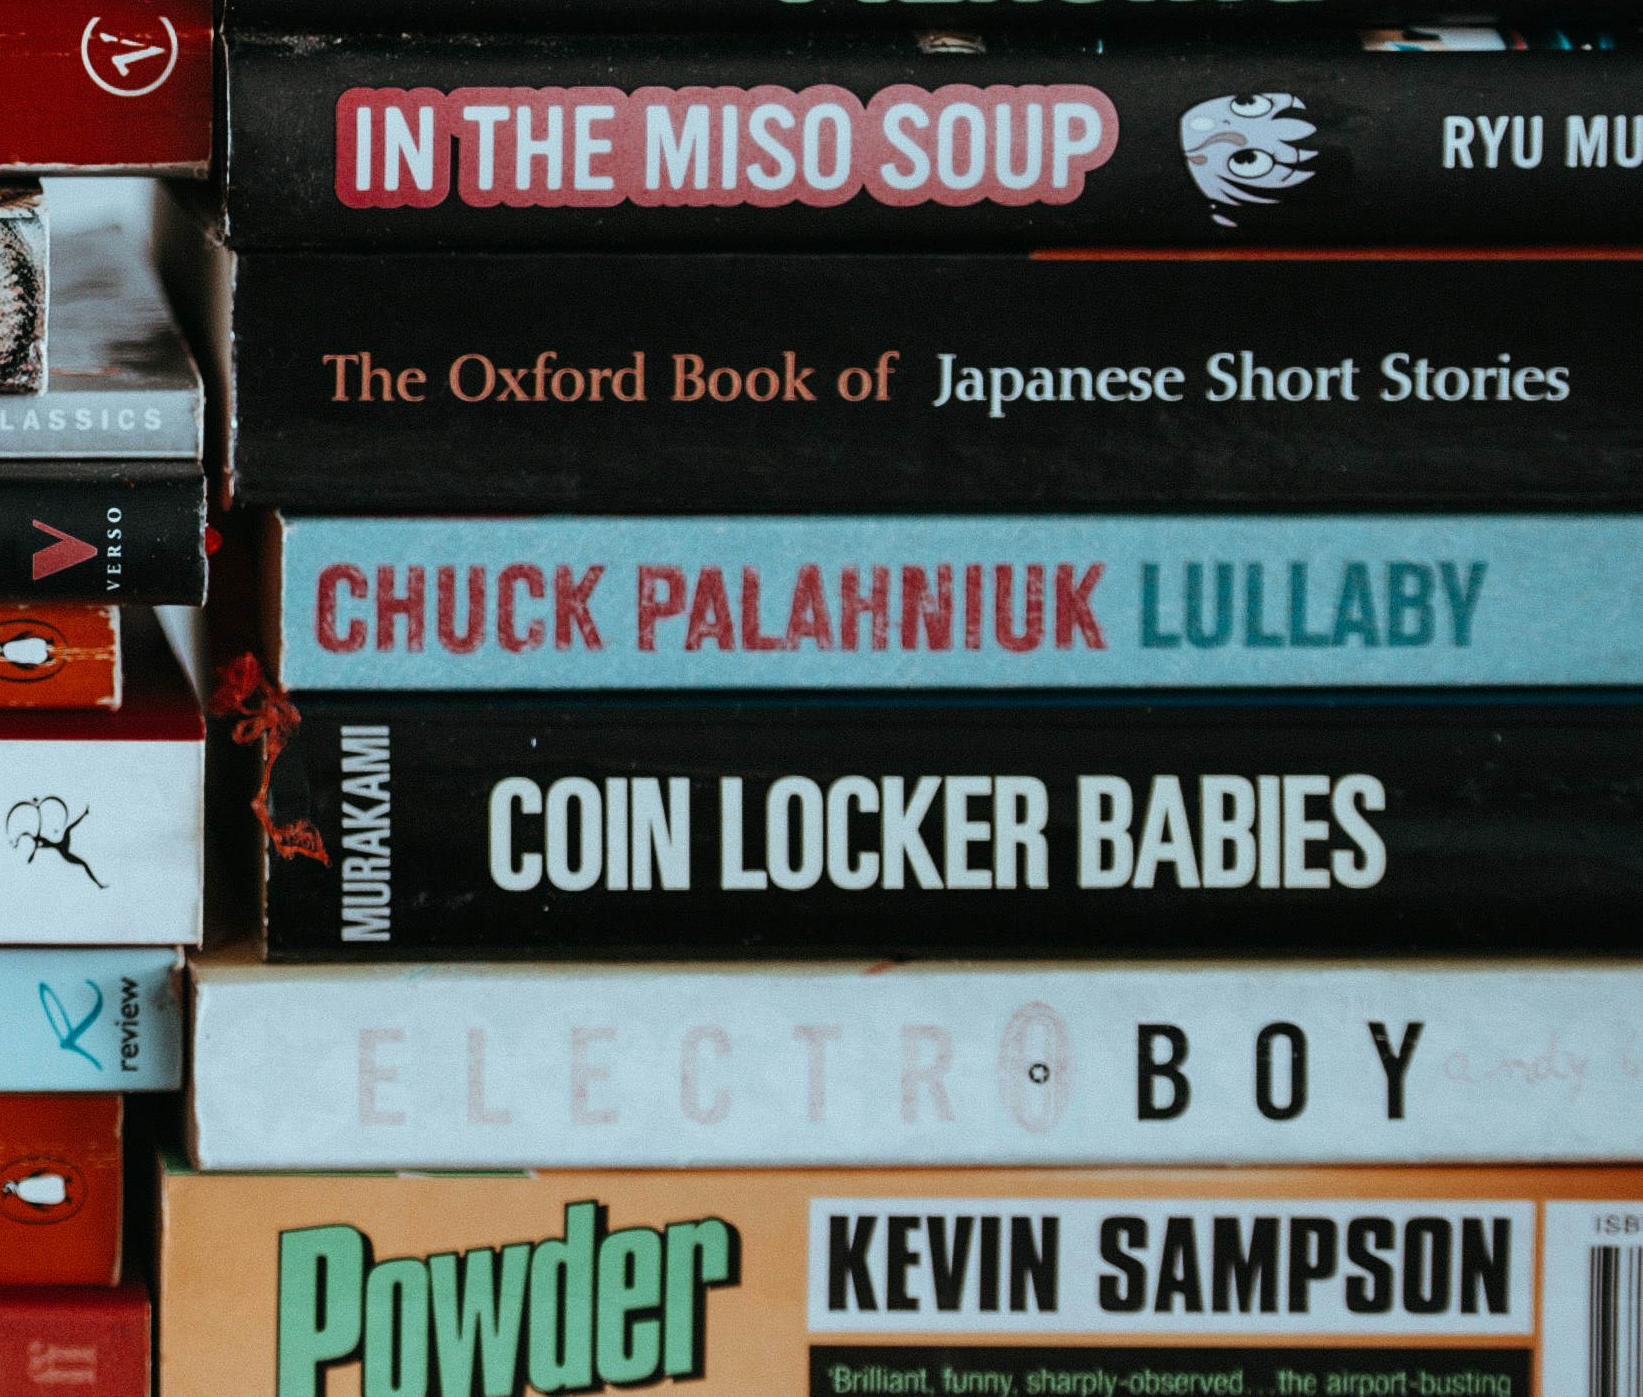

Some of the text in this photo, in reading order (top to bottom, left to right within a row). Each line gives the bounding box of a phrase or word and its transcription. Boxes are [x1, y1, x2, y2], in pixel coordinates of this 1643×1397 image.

[355, 101, 1102, 192] IN THE MISO SOUP
[322, 350, 1570, 418] The Oxford Book of Japanese Short Stories
[106, 507, 122, 590] VERSO
[315, 561, 1488, 655] CHUCK PALAHNIUK LULLABY
[340, 726, 391, 941] MURAKAMI
[490, 774, 1386, 891] COIN LOCKER BABIES
[116, 975, 140, 1074] review
[1137, 1021, 1424, 1122] BOY
[277, 1199, 741, 1397] Powder
[828, 1215, 1511, 1314] KEVIN SAMPSON
